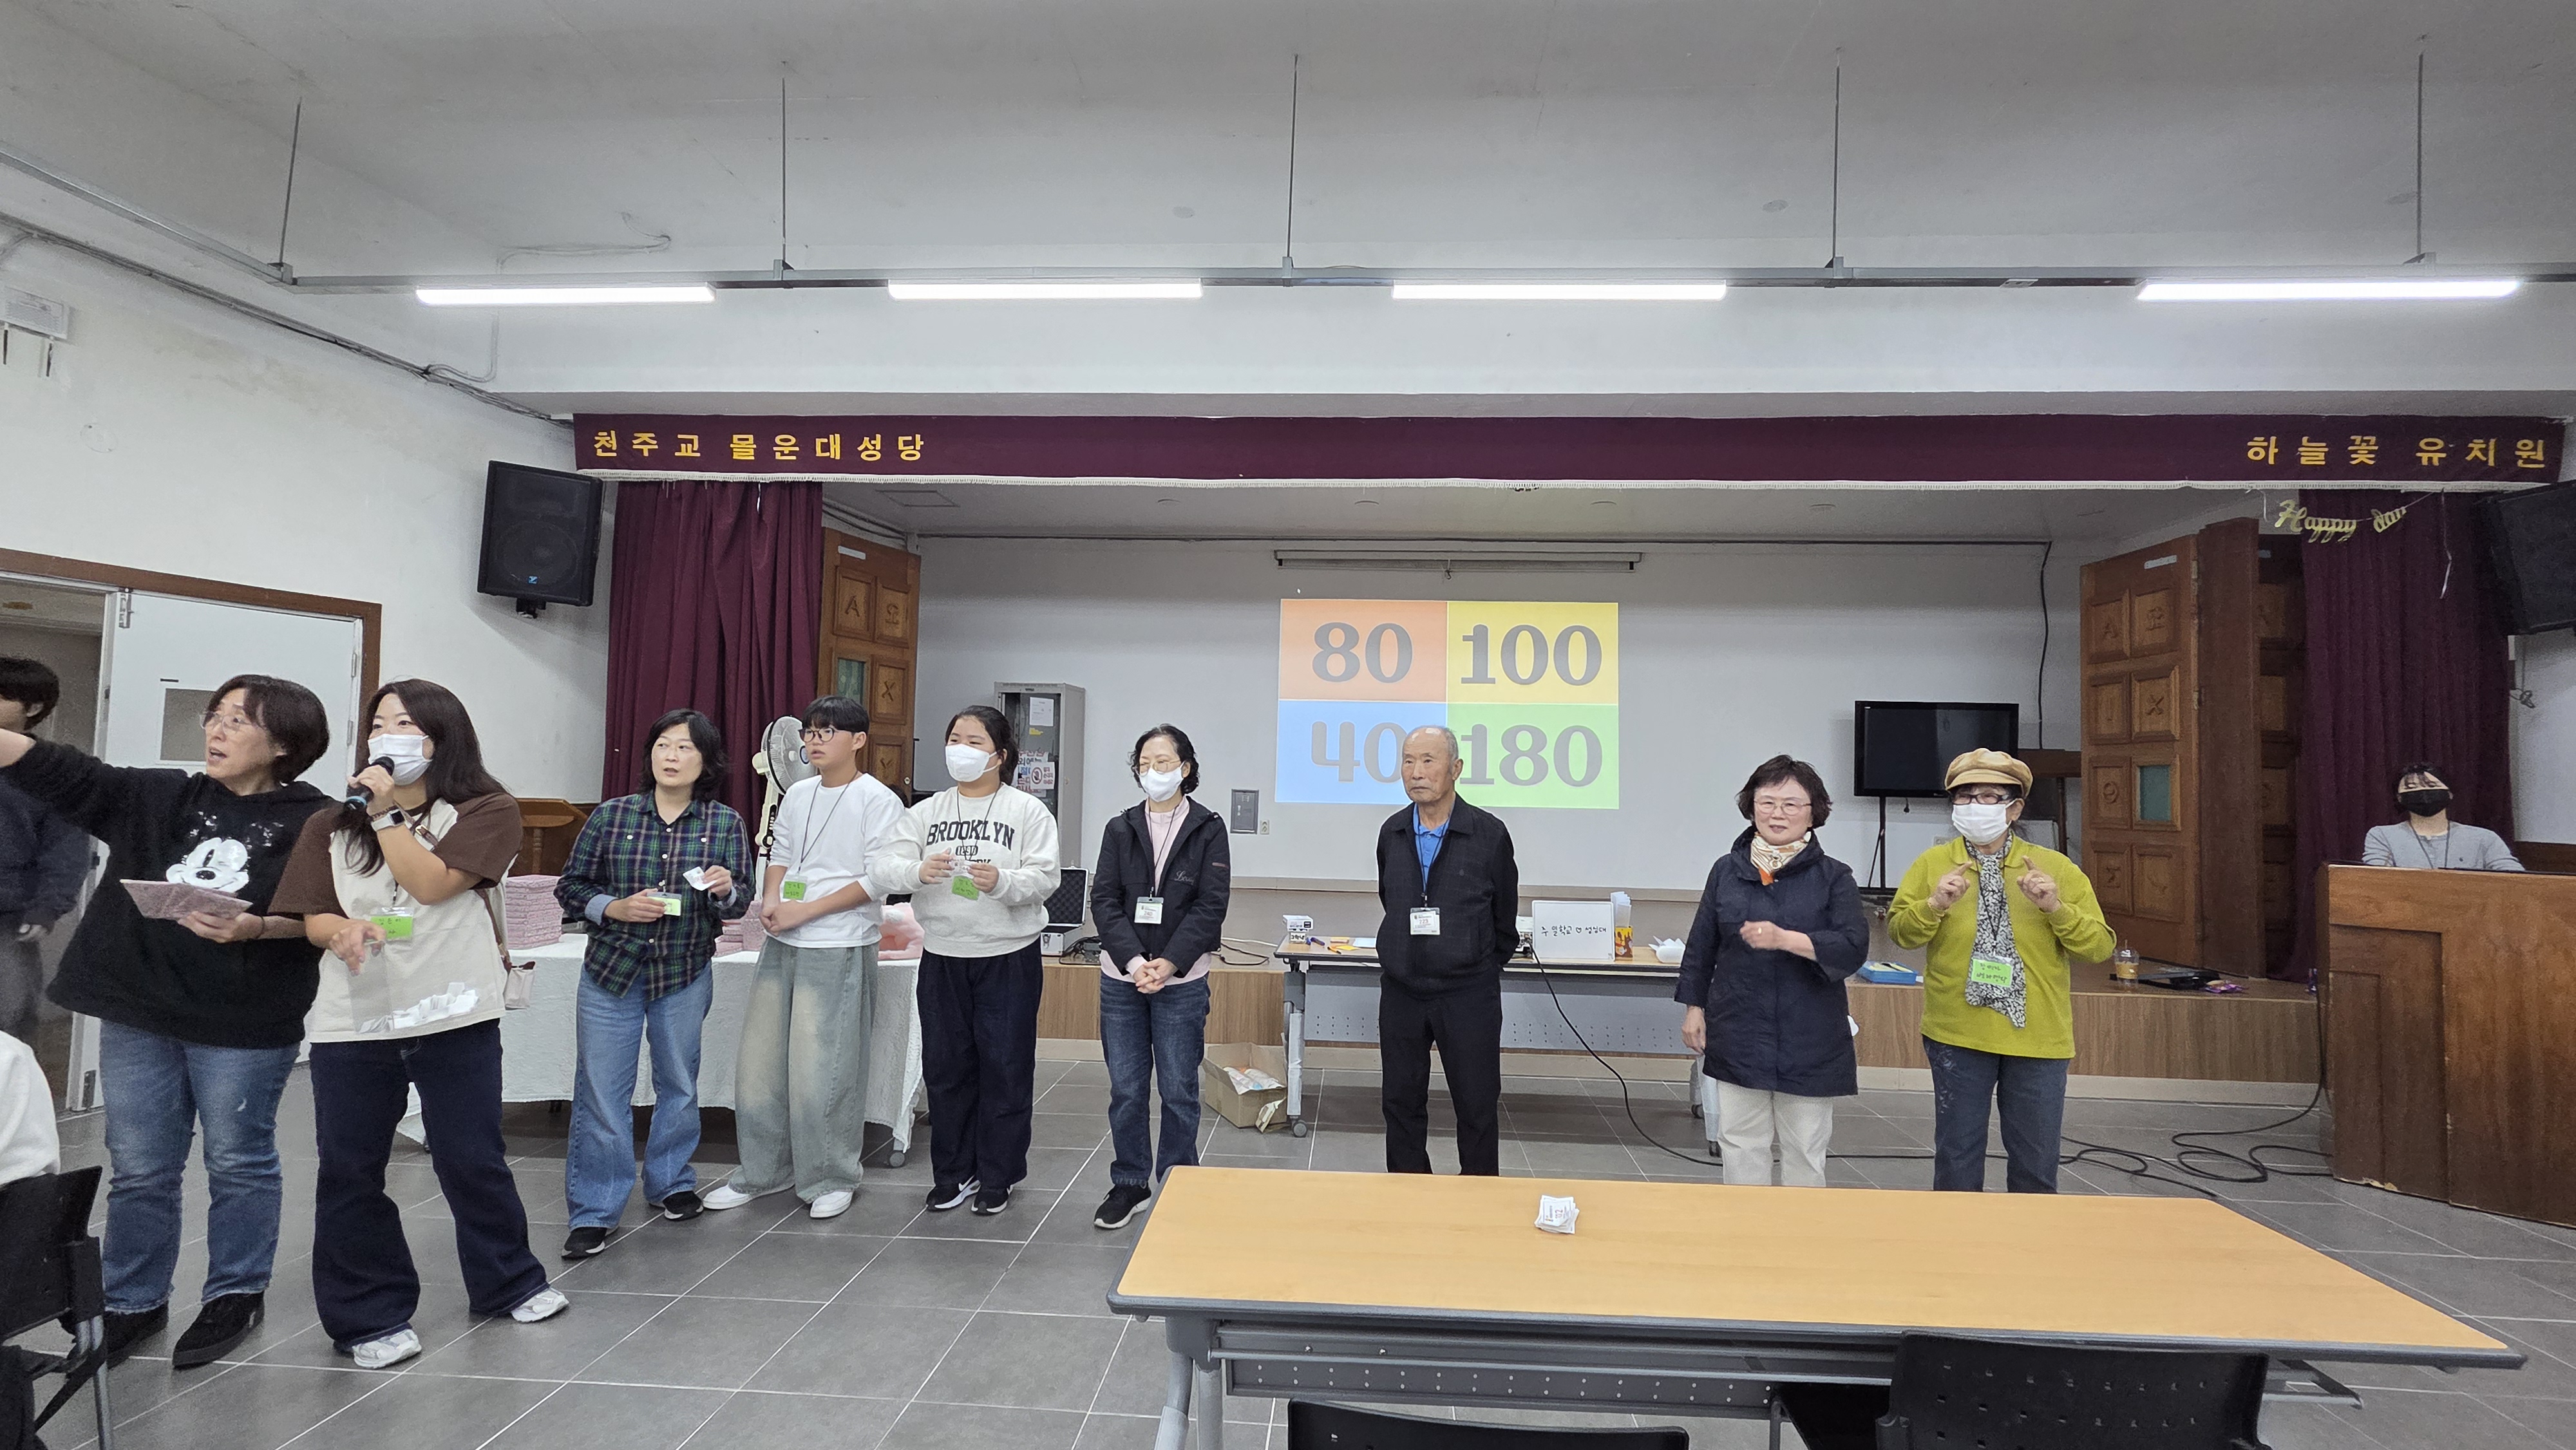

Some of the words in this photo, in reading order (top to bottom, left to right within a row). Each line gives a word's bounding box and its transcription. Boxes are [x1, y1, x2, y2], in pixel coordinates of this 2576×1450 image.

[593, 431, 701, 457] 천주교
[2247, 435, 2379, 465] 하늘꽃
[2416, 437, 2546, 469] 유치원
[2275, 500, 2357, 543] Happy
[1312, 621, 1413, 684] 80
[1461, 623, 1602, 686] 100
[1311, 721, 1408, 784] 40
[1459, 724, 1603, 787] 180
[926, 819, 1015, 851] BROOKLYN
